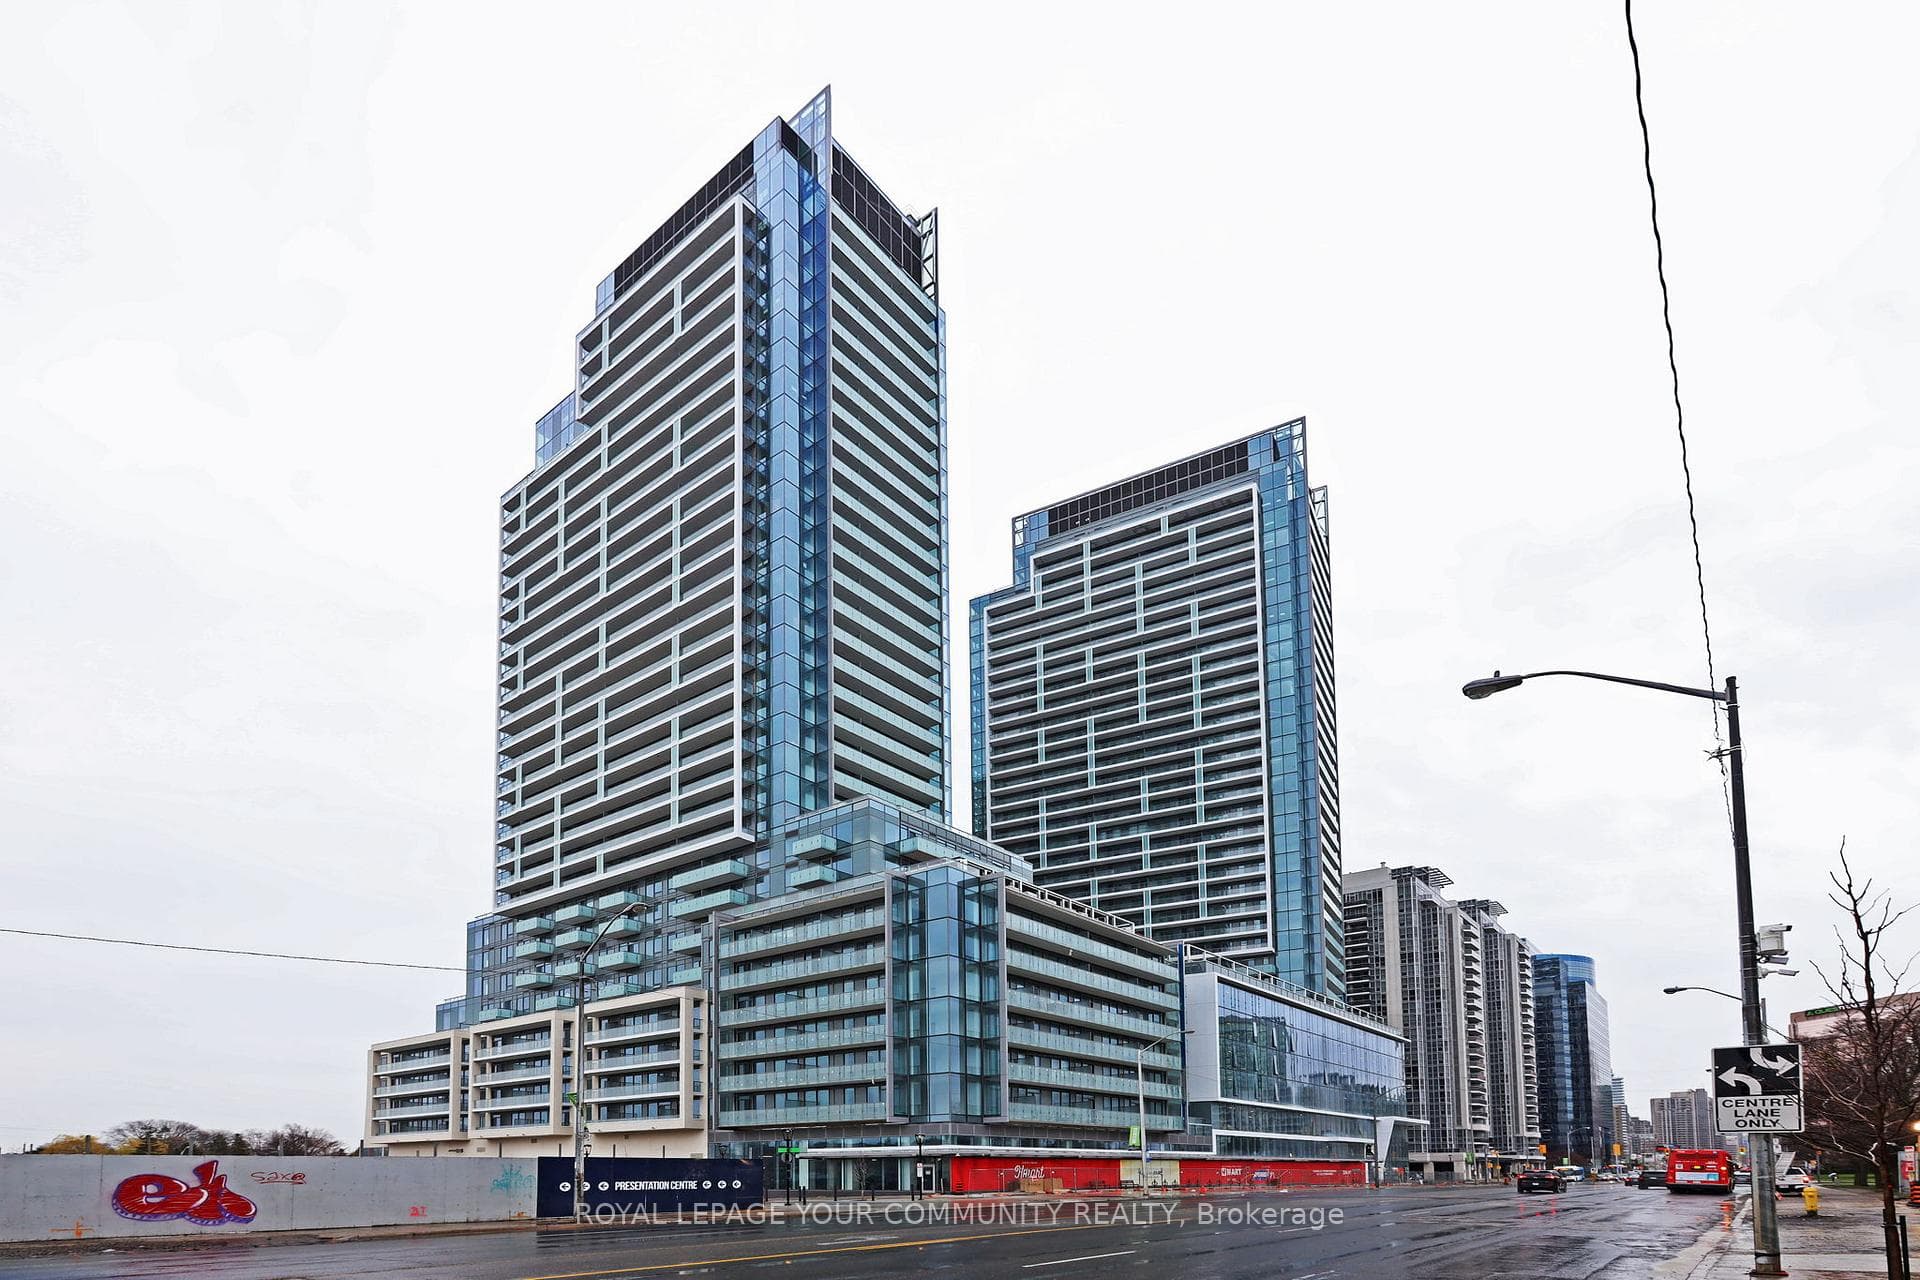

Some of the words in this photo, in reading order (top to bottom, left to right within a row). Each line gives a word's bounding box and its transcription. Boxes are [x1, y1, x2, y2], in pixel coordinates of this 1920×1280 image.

[1722, 1098, 1793, 1108] CENTRE
[1734, 1109, 1780, 1118] LANE
[1735, 1119, 1779, 1128] ONLY
[615, 1181, 669, 1191] PRESENTATION
[670, 1181, 698, 1190] CENTRE
